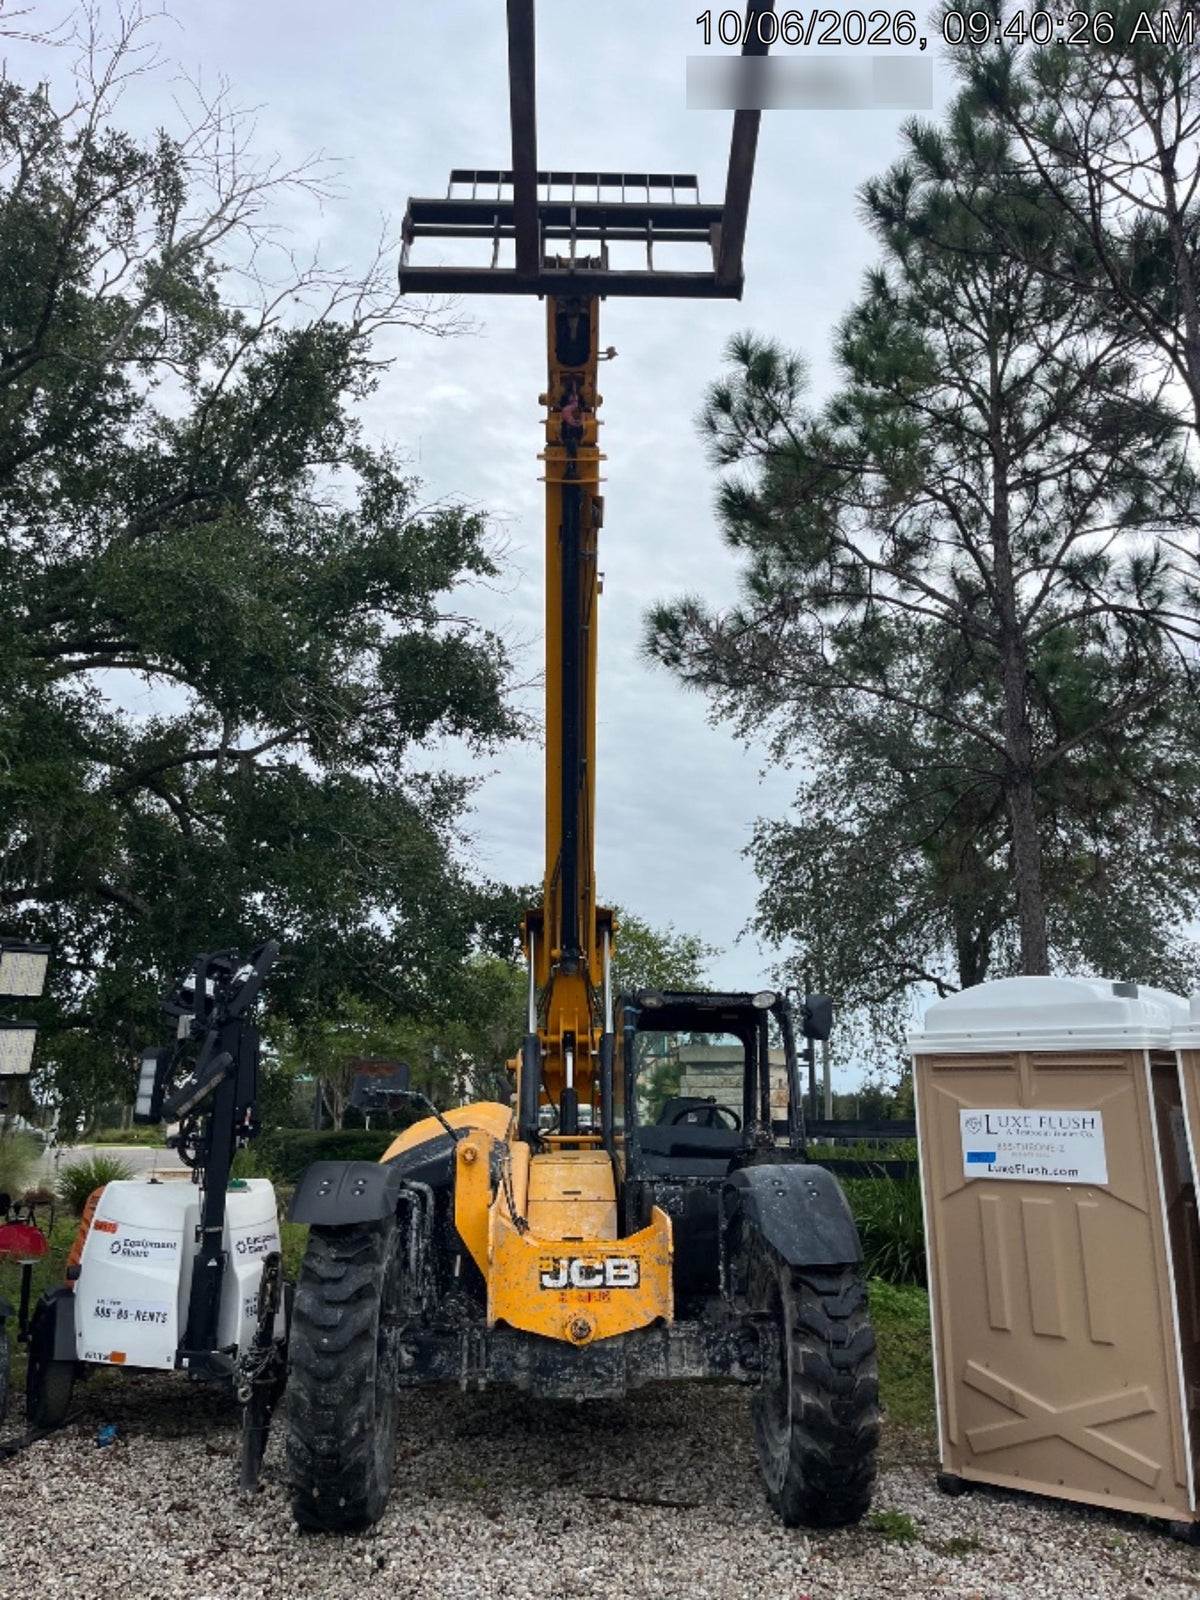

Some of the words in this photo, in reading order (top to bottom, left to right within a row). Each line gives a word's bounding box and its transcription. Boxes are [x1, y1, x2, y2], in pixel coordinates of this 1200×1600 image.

[985, 1114, 1032, 1135] LUXE
[1039, 1116, 1095, 1130] FLUSH
[988, 1164, 1079, 1177] LuxeFlush.com
[541, 1257, 639, 1289] JCB
